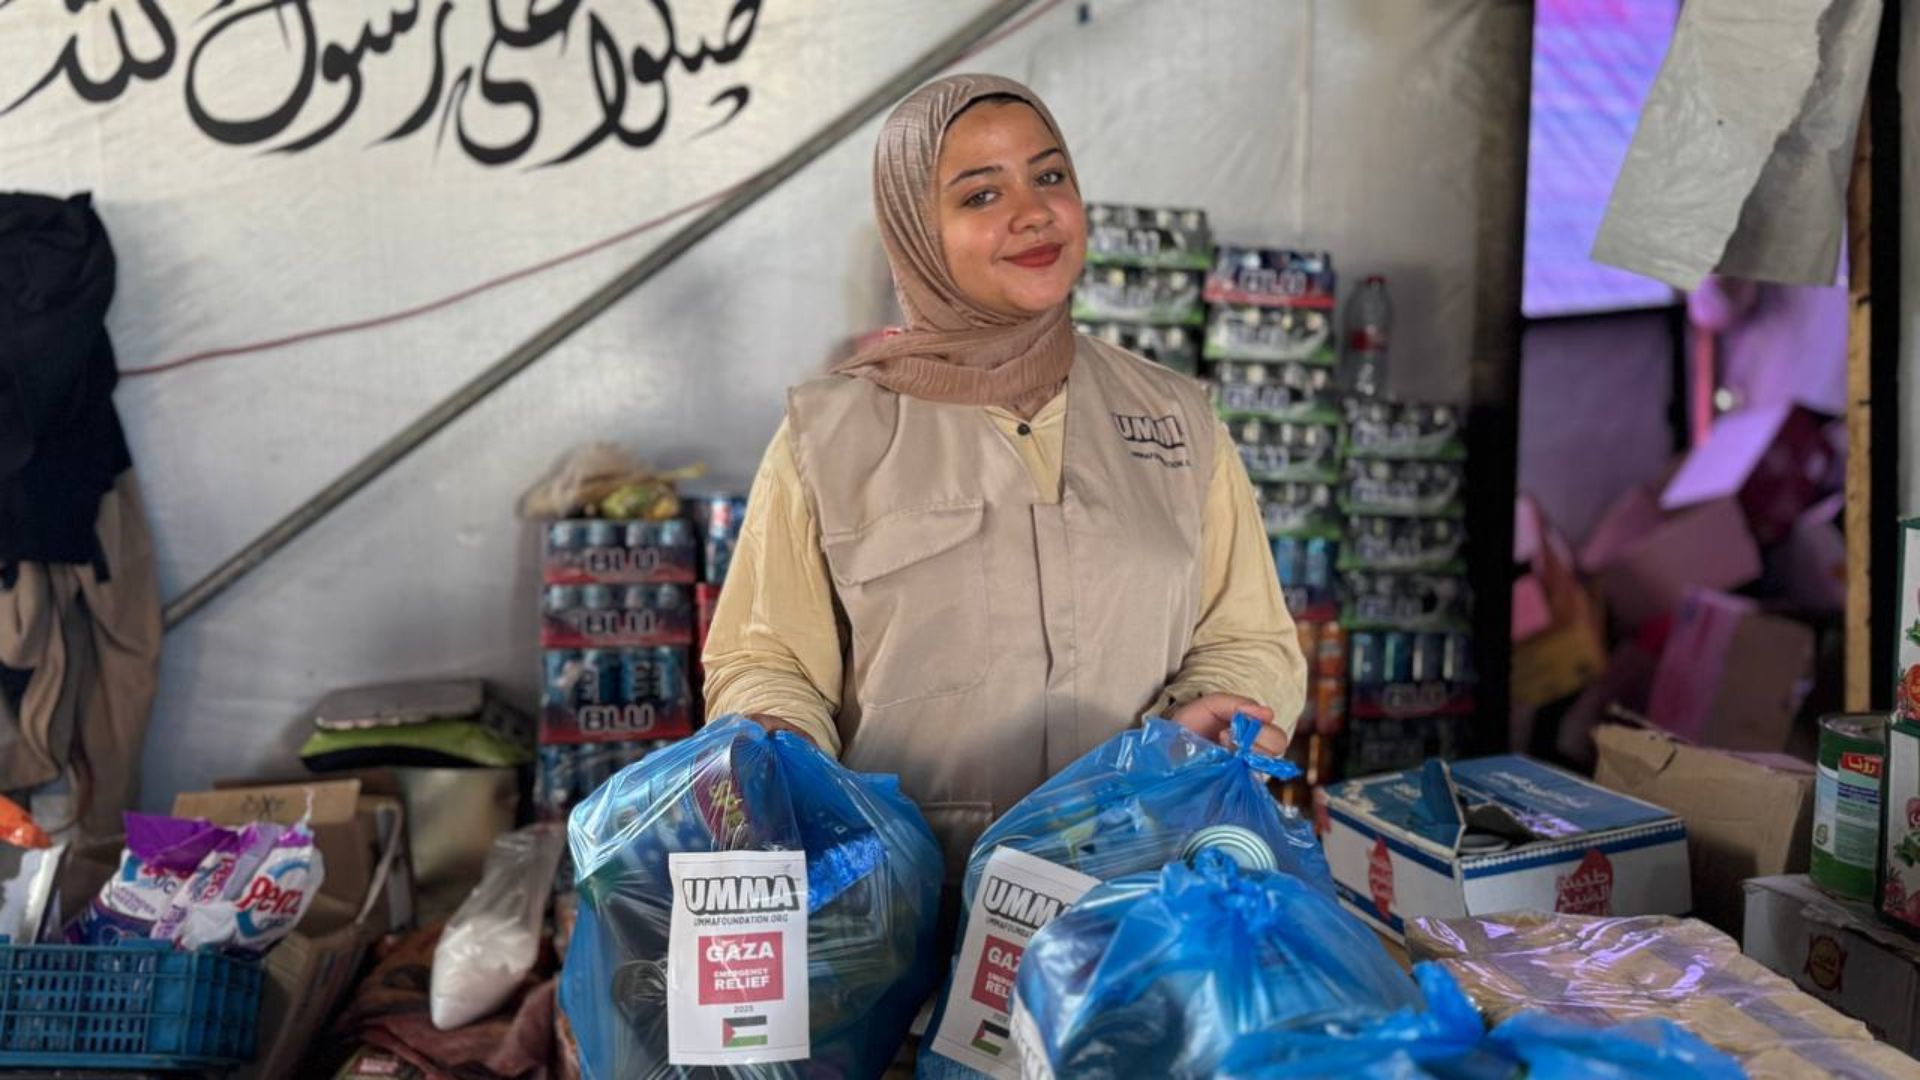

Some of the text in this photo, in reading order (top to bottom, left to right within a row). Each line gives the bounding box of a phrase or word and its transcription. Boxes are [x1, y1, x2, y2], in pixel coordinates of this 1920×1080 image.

[579, 703, 654, 734] BLU
[682, 875, 800, 916] UMMA
[982, 875, 1072, 930] UMM
[693, 913, 789, 927] UMMAFOUNDATION.ORG
[706, 940, 776, 963] GAZA
[987, 946, 1021, 973] GA
[714, 976, 771, 991] RELIEF
[984, 980, 1010, 999] REL
